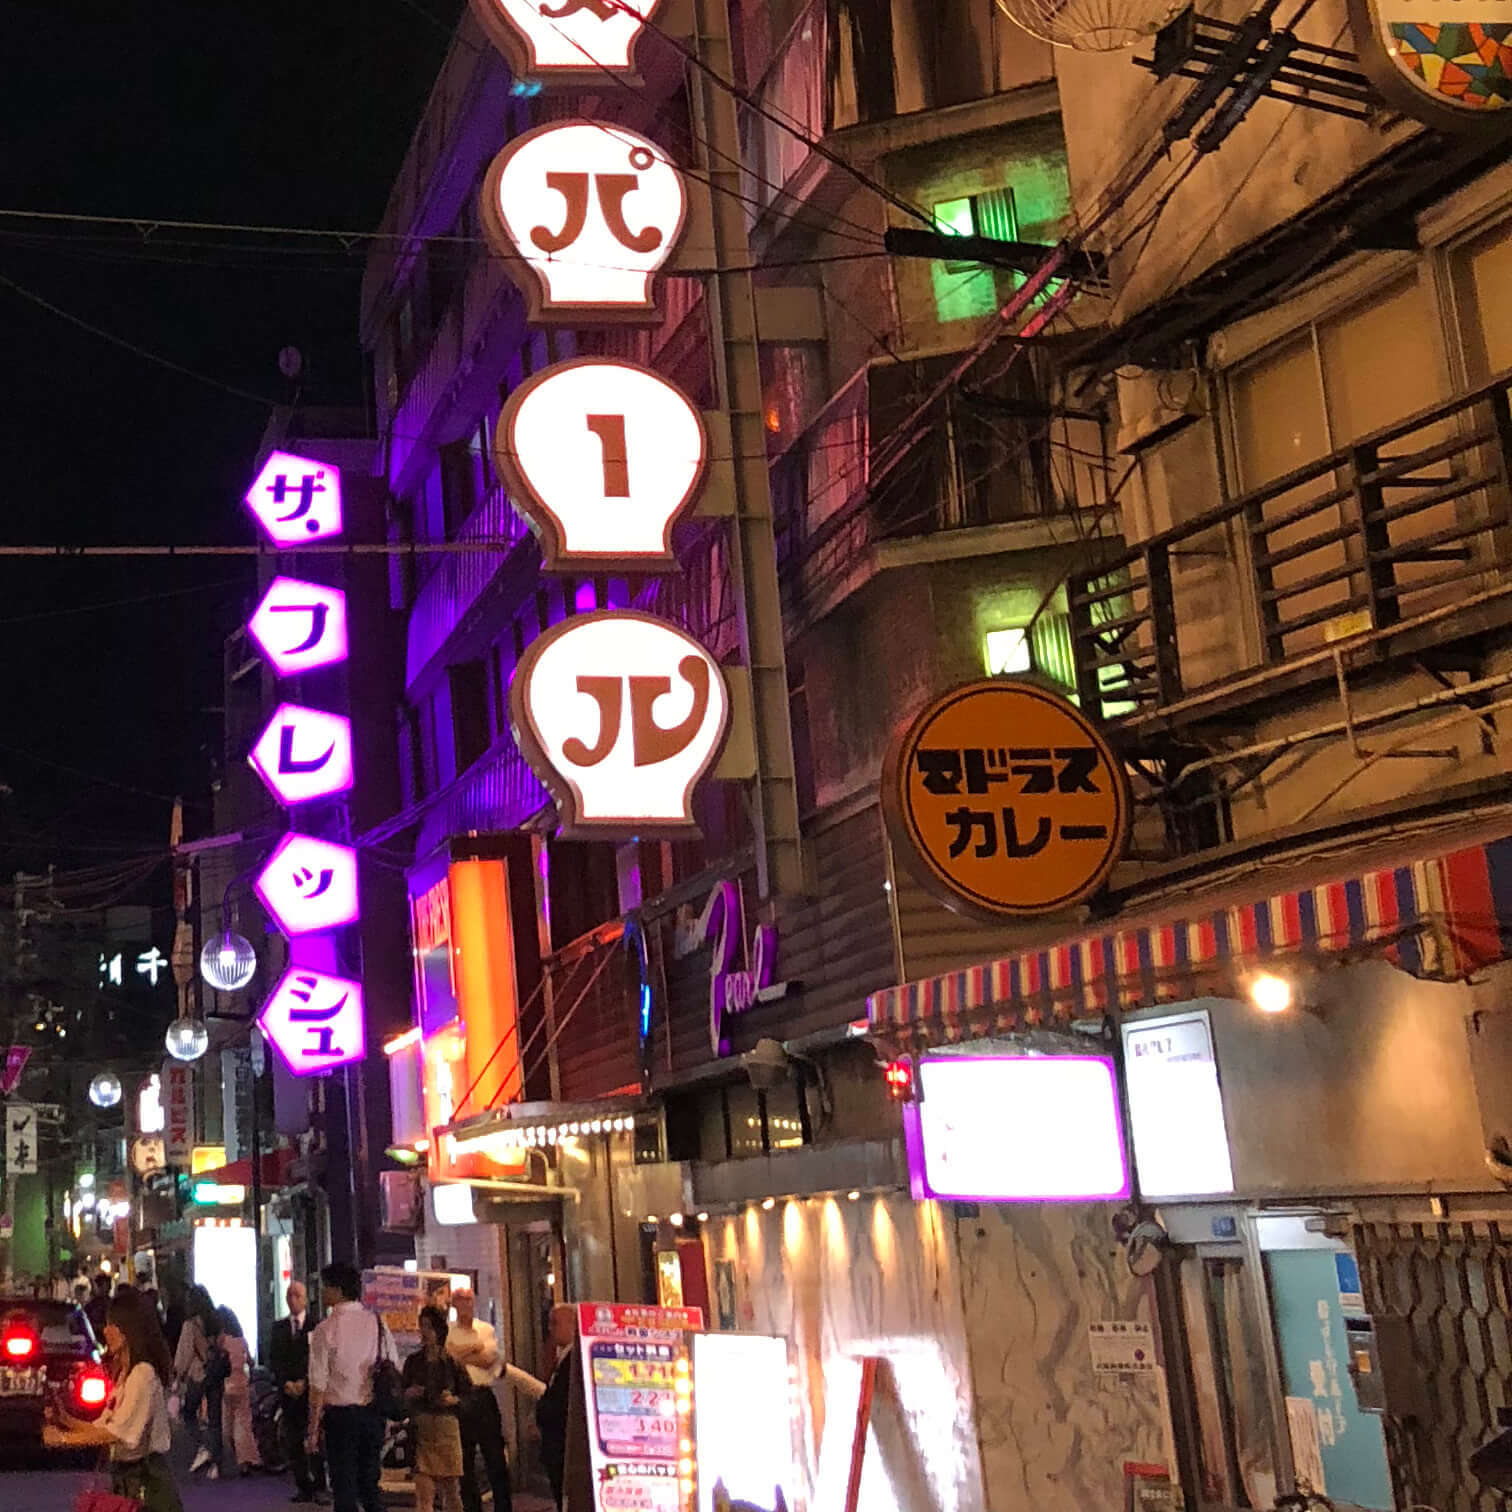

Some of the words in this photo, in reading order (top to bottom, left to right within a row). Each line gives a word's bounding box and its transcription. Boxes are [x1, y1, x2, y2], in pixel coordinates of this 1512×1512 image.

[916, 748, 1102, 795] マドラス
[945, 806, 1108, 859] カレー
